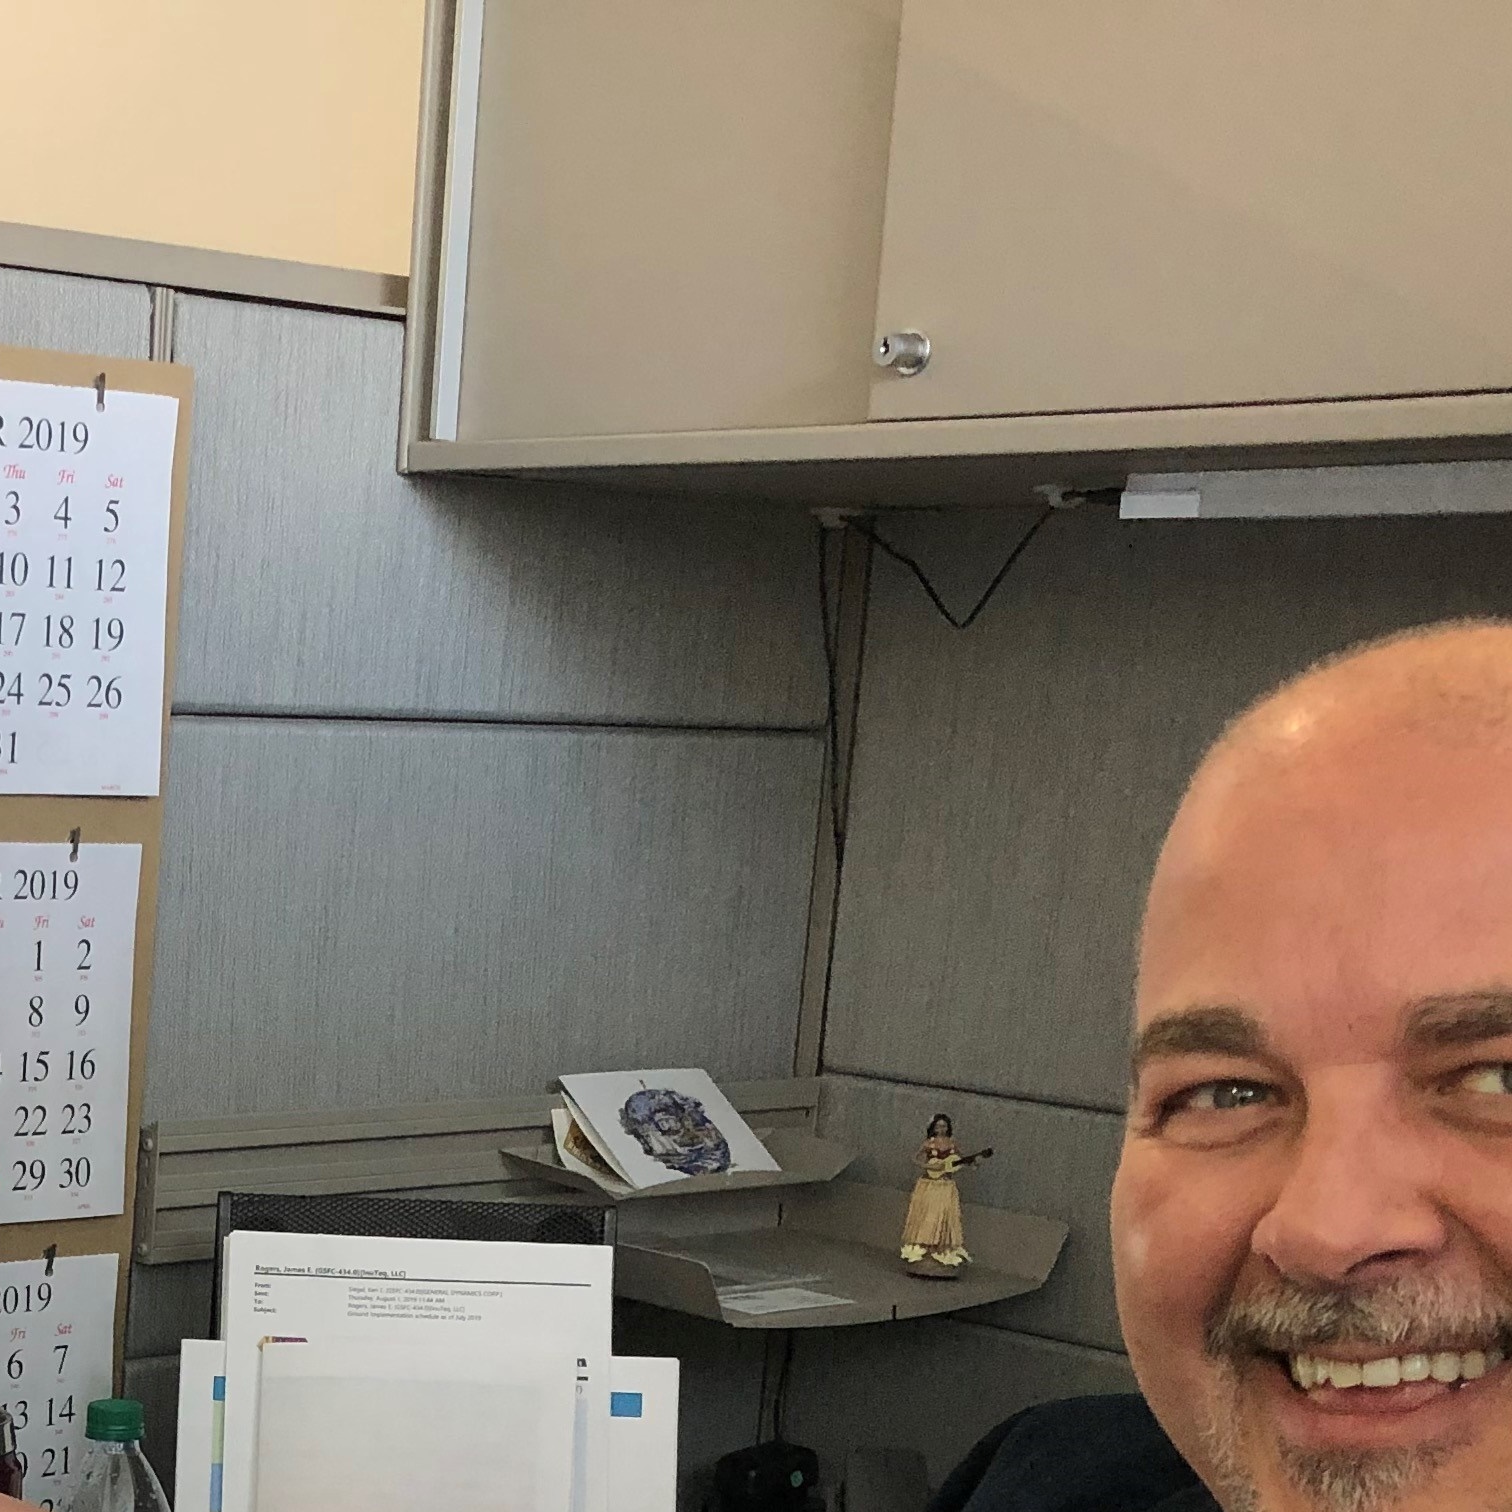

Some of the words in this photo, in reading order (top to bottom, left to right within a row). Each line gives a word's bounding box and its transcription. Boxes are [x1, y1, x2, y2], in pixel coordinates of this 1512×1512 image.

[18, 417, 89, 453] 2019
[3, 464, 26, 479] Thu
[56, 470, 76, 485] Fri
[104, 474, 124, 488] Sat
[4, 491, 21, 525] 3
[53, 496, 72, 529] 4
[103, 500, 120, 532] 5
[47, 555, 73, 589] 11
[96, 559, 126, 592] 12
[45, 615, 74, 648] 18
[93, 618, 124, 651] 19
[37, 673, 72, 706] 25
[86, 676, 122, 708] 26
[13, 870, 79, 900] 2019
[33, 916, 50, 930] Fri
[77, 916, 96, 929] Sat
[33, 940, 45, 972] 1
[76, 939, 92, 970] 2
[28, 996, 44, 1027] 8
[74, 994, 90, 1026] 9
[19, 1051, 50, 1082] 15
[66, 1049, 96, 1080] 16
[13, 1105, 48, 1136] 22
[60, 1103, 92, 1134] 23
[11, 1160, 46, 1191] 29
[58, 1157, 91, 1188] 30
[9, 1326, 28, 1342] Fri
[54, 1322, 74, 1337] Sat
[6, 1349, 25, 1379] 6
[52, 1345, 70, 1375] 7
[45, 1395, 77, 1426] 14
[39, 1446, 73, 1477] 21
